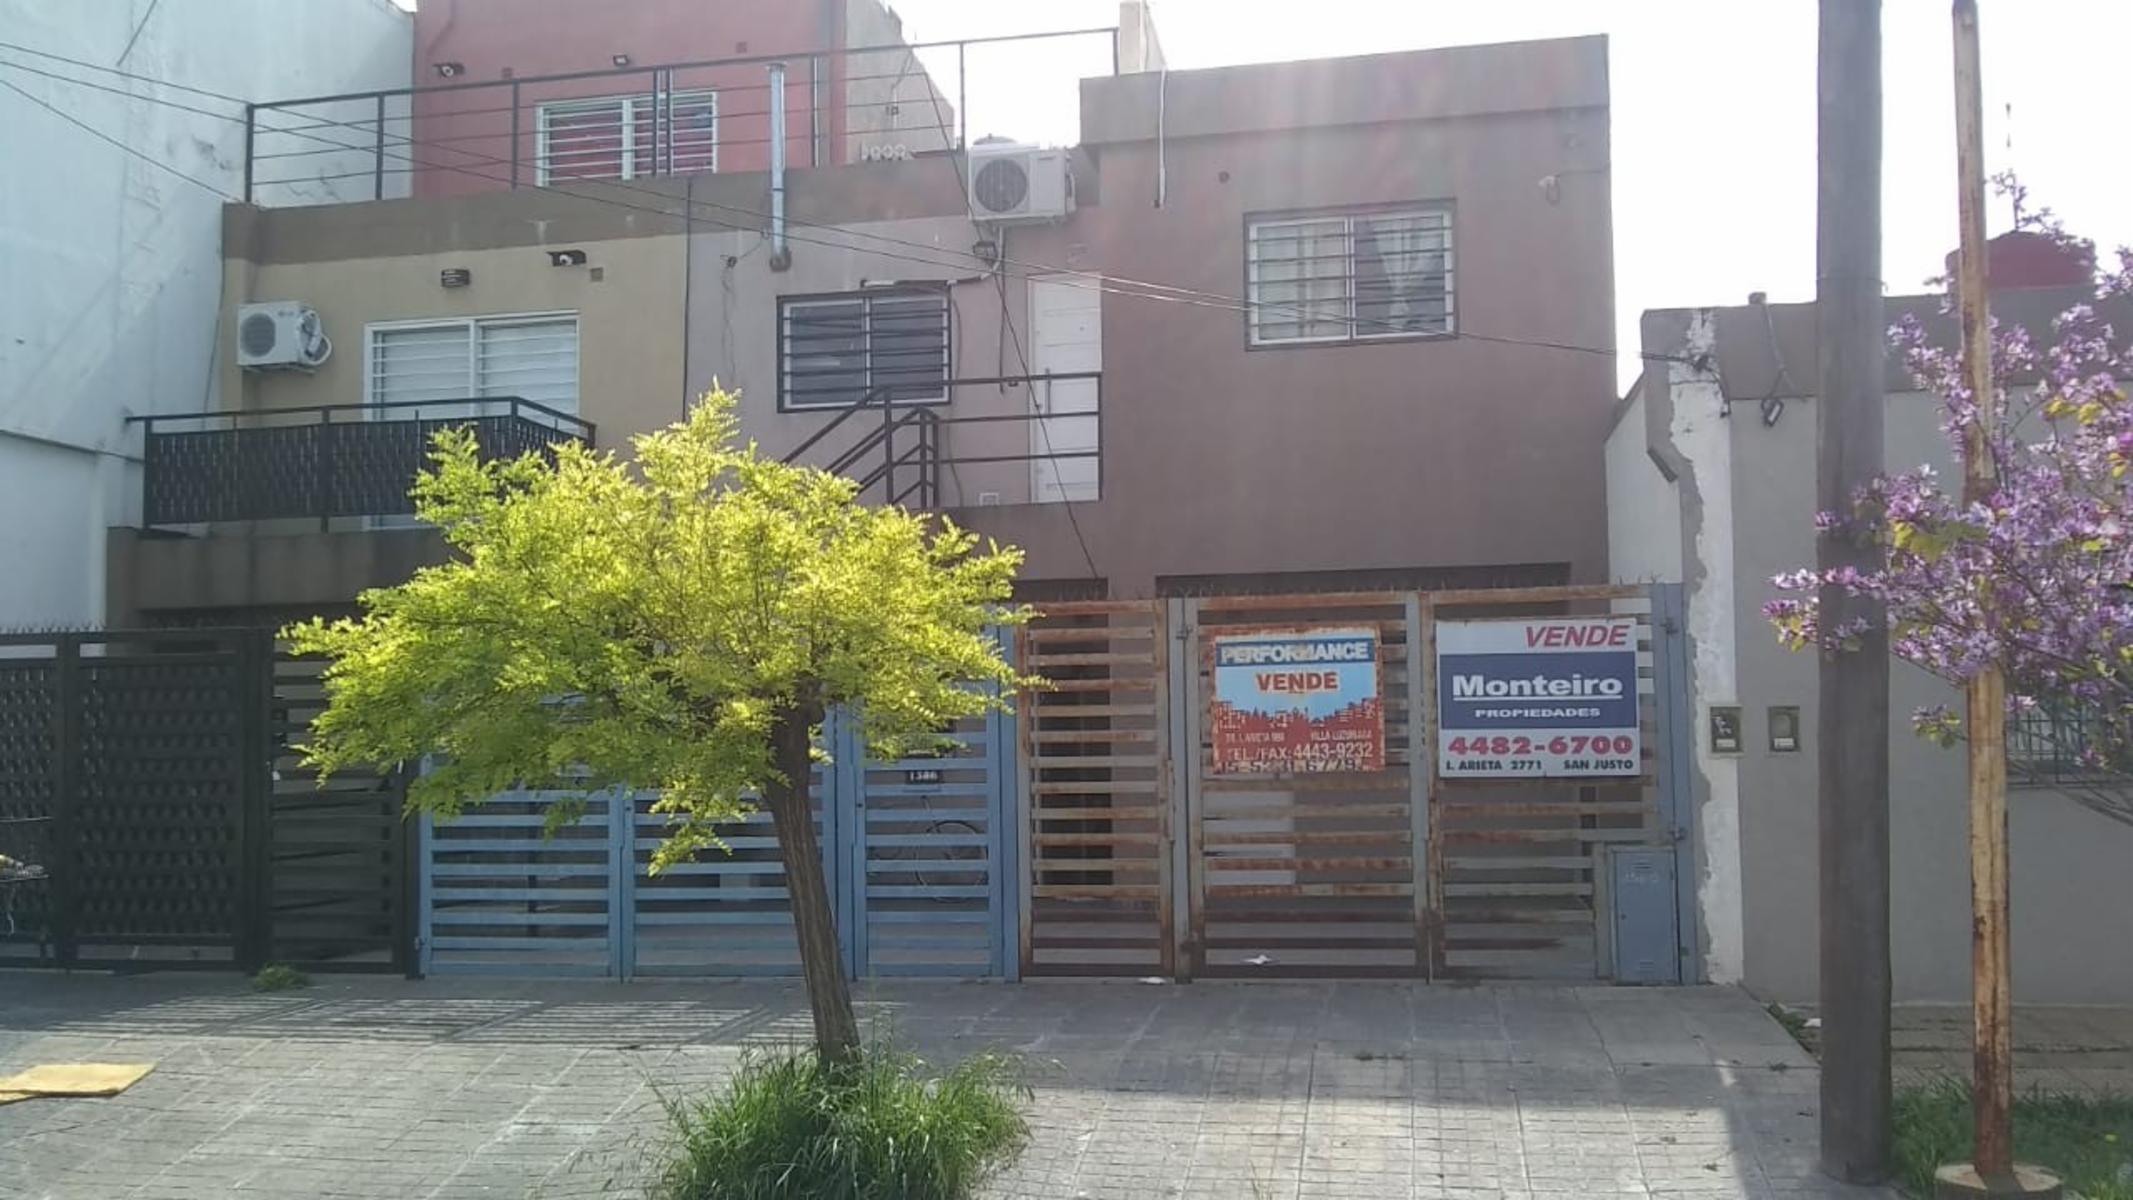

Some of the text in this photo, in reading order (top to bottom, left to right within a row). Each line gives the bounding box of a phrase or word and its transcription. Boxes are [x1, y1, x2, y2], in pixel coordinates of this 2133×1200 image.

[1525, 625, 1630, 648] VENDE
[1220, 643, 1369, 664] PERFORMANCE
[1256, 671, 1338, 691] VENDE
[1452, 674, 1623, 697] Monteiro
[1475, 707, 1601, 718] PROPIEDADES
[1293, 741, 1373, 761] 4443-9232
[1448, 735, 1634, 755] 4482-6700
[1458, 760, 1502, 770] ARIETA
[1510, 760, 1542, 770] 2771
[1564, 760, 1589, 770] SAN
[1593, 759, 1634, 770] JUSTO
